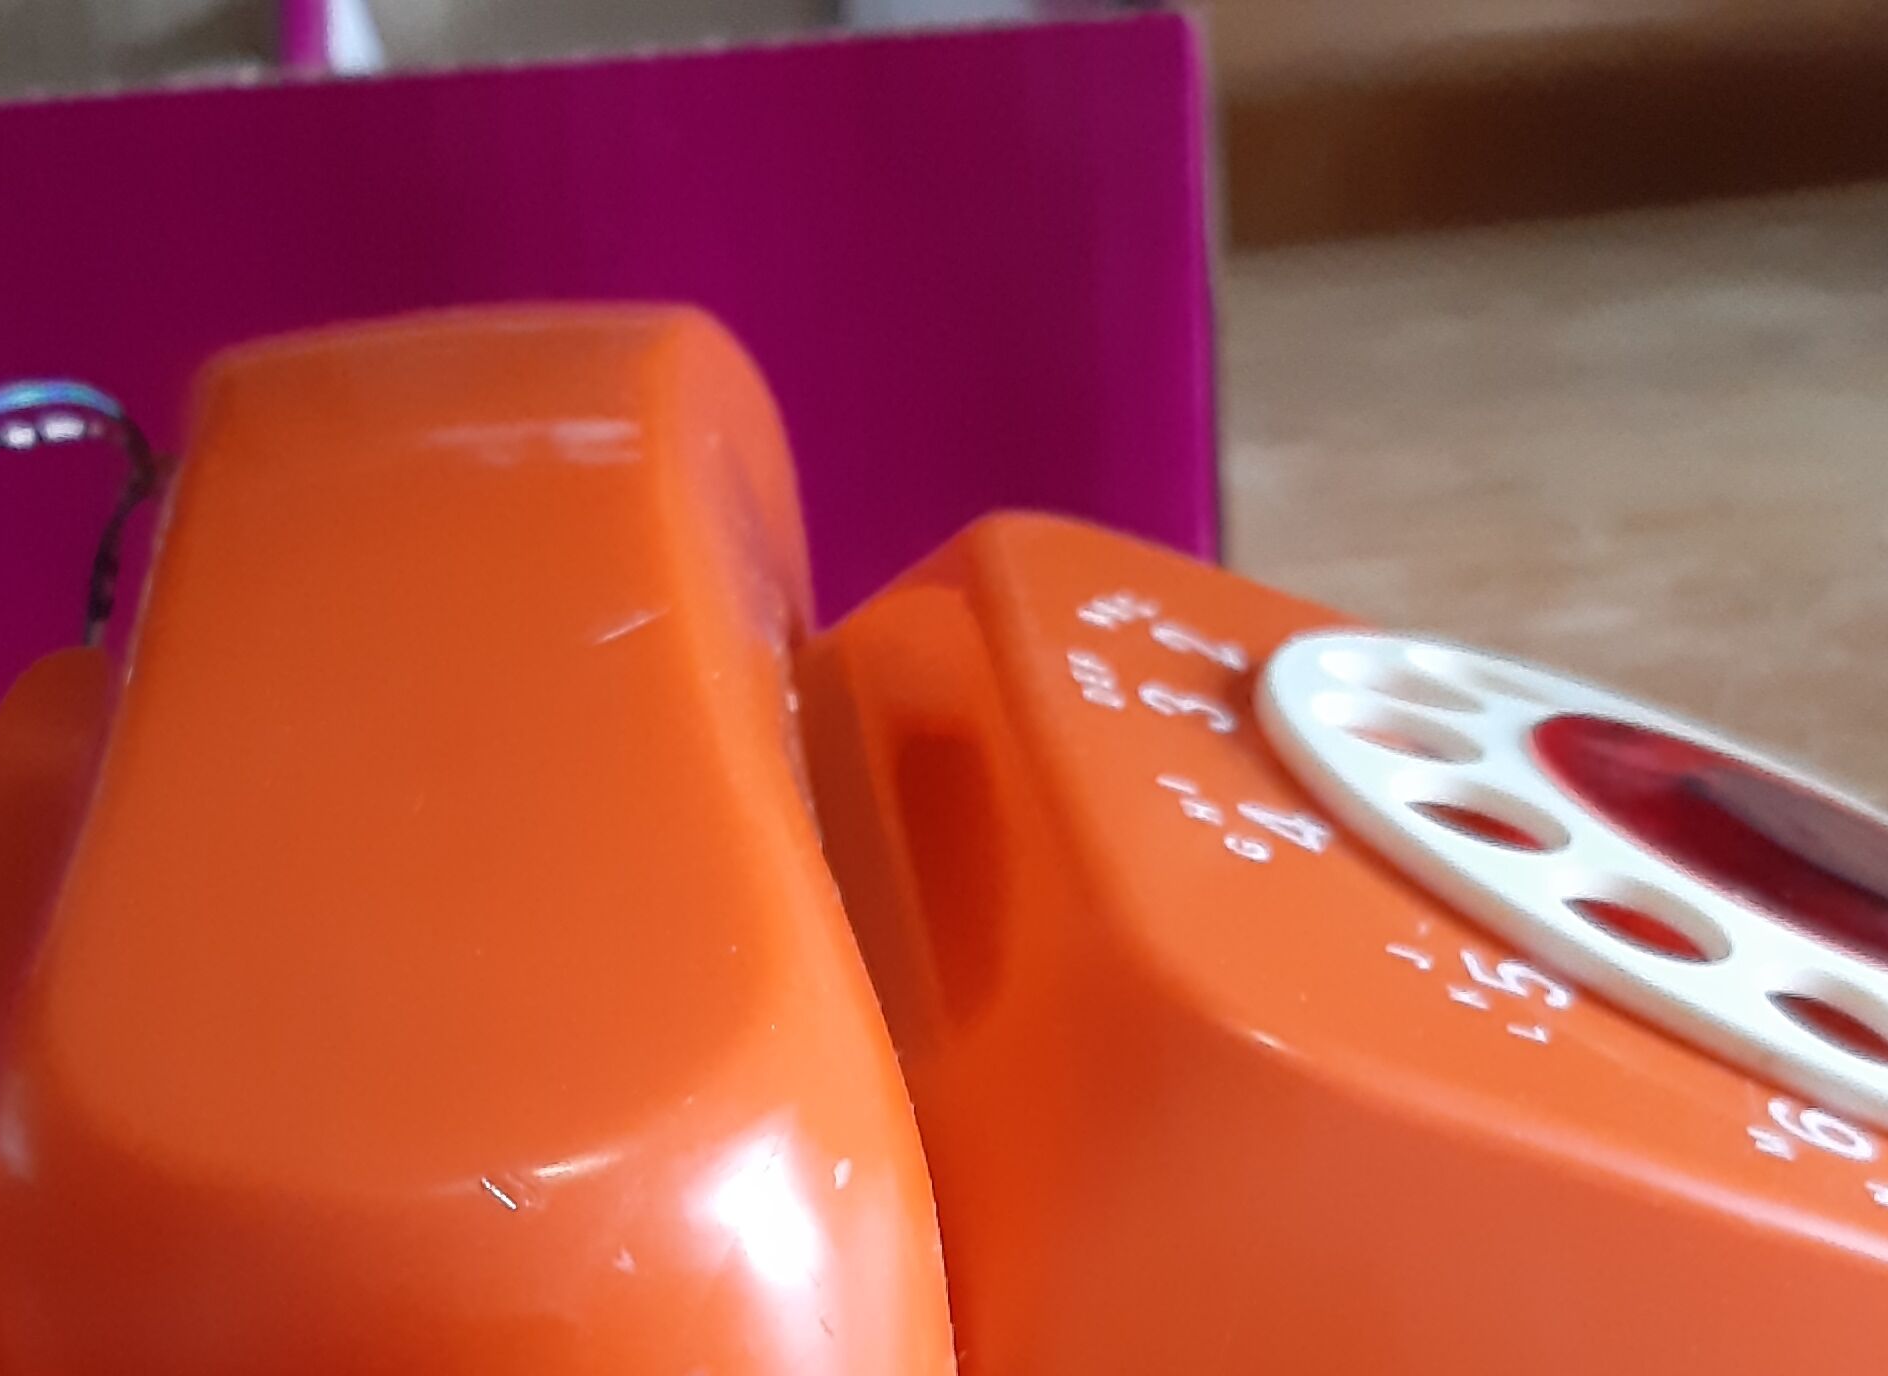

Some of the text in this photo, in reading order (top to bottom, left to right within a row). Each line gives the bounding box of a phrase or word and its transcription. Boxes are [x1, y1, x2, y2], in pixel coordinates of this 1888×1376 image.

[1150, 622, 1246, 673] 2
[1137, 681, 1237, 734] 3
[1236, 802, 1332, 855] 4
[1460, 950, 1571, 1009] 5
[1767, 1097, 1878, 1163] 6
